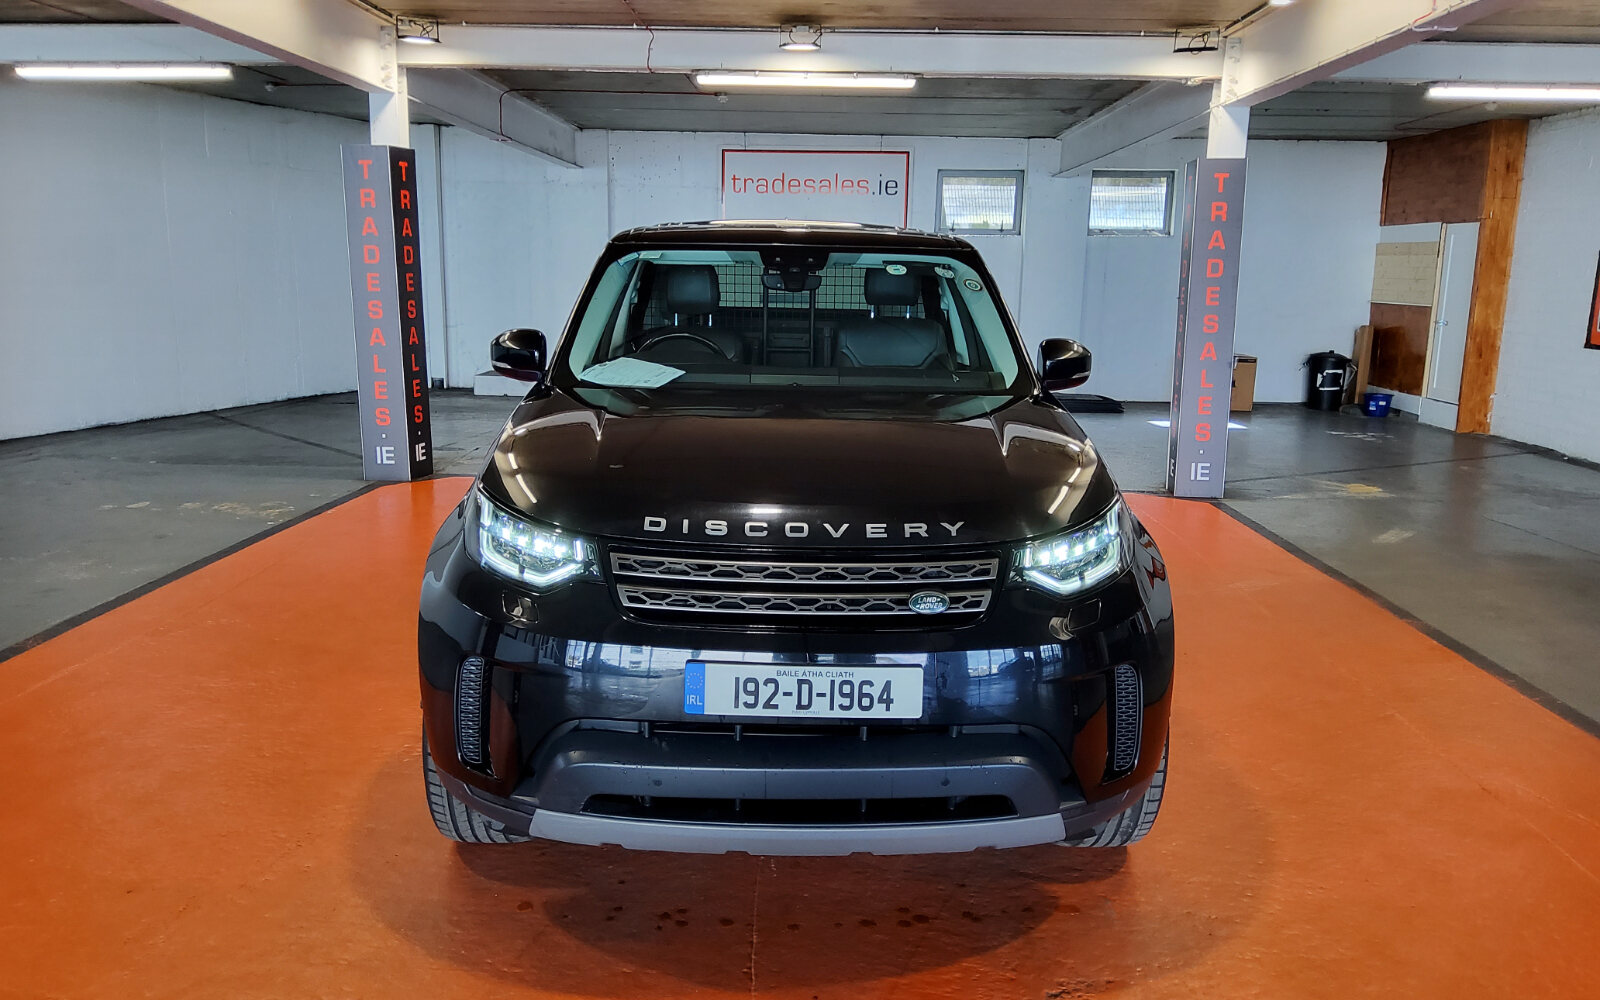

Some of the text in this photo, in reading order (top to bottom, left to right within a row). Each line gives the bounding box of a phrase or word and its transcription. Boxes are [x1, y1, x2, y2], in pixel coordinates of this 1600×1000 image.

[731, 172, 898, 196] tradesales.ie
[643, 516, 965, 539] DISCOVERY
[917, 596, 937, 604] LAND
[919, 602, 943, 610] ROVER
[776, 670, 799, 678] BAILE
[825, 671, 854, 679] CLIATH
[686, 694, 703, 706] IRL
[733, 676, 894, 712] 192-D-1964
